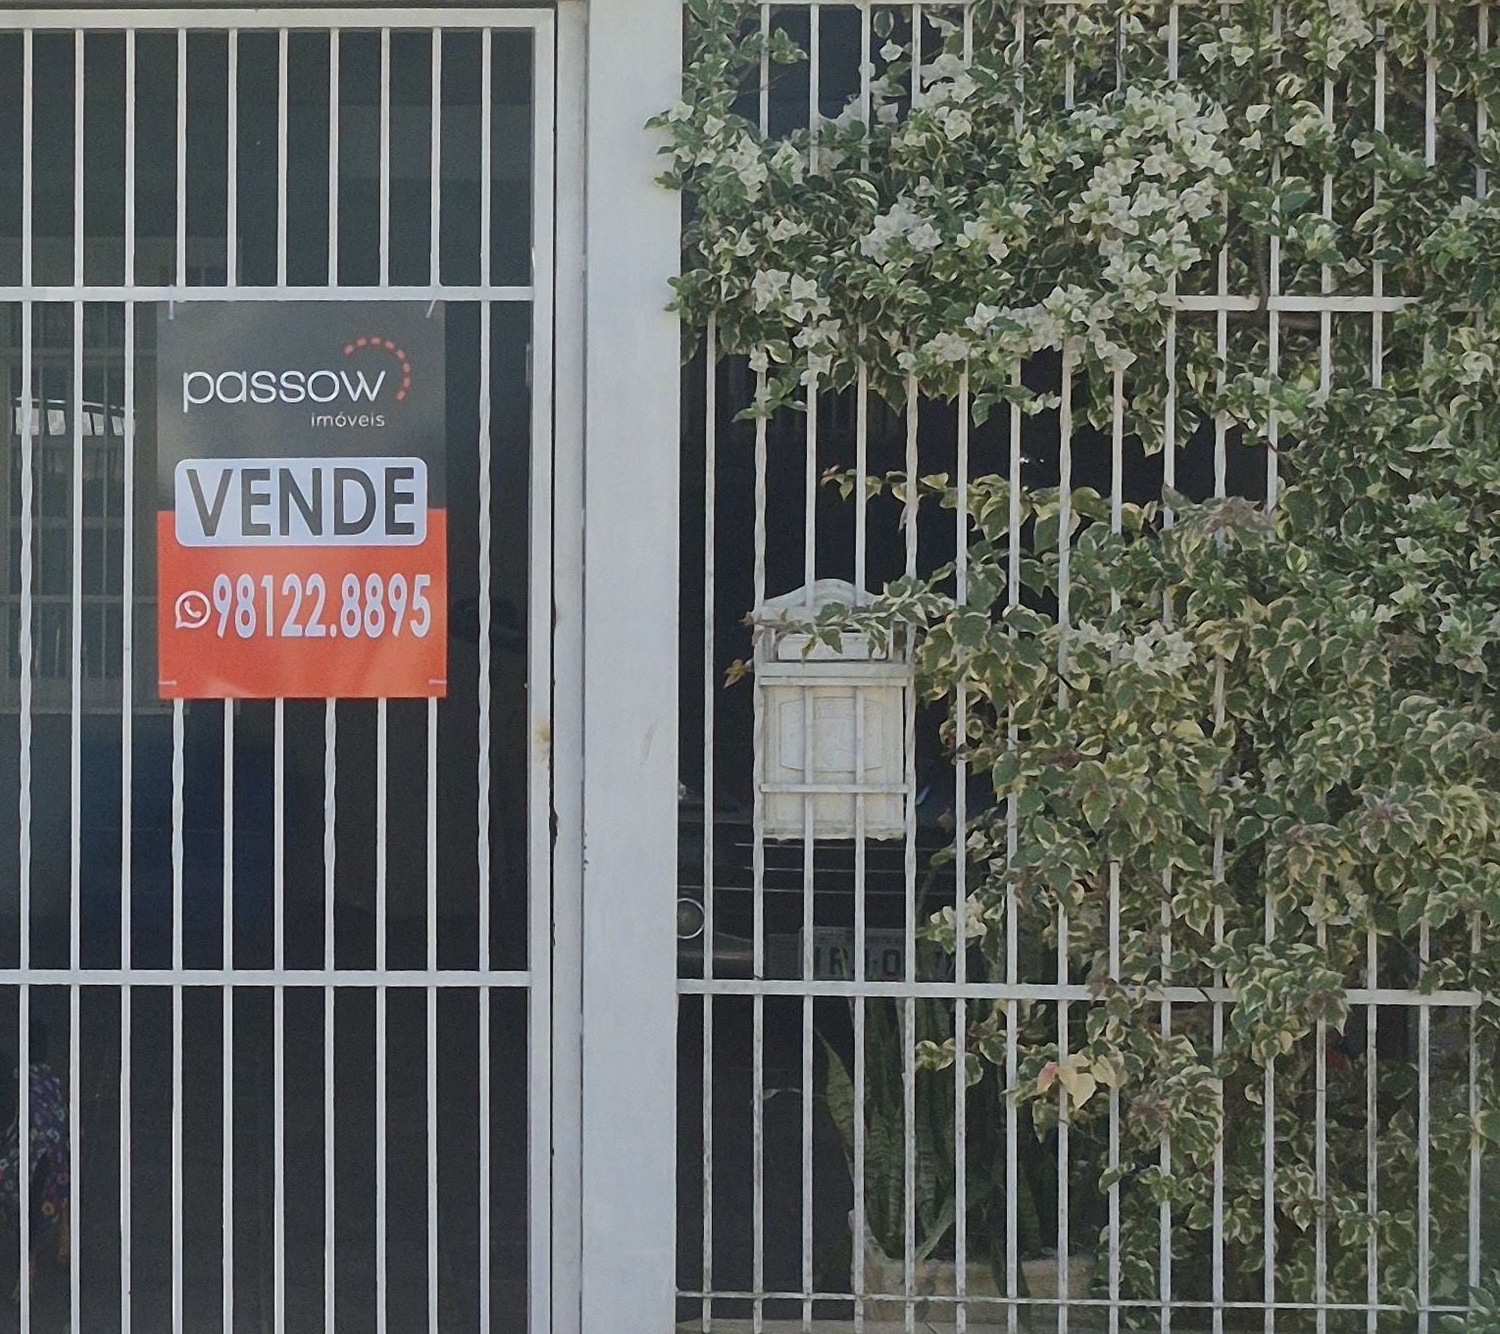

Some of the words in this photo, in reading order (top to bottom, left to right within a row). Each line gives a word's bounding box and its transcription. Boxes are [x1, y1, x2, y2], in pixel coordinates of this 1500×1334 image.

[182, 369, 387, 414] passow
[310, 410, 386, 428] imóveis
[186, 466, 416, 538] VENDE
[212, 572, 432, 640] 98122.8895
